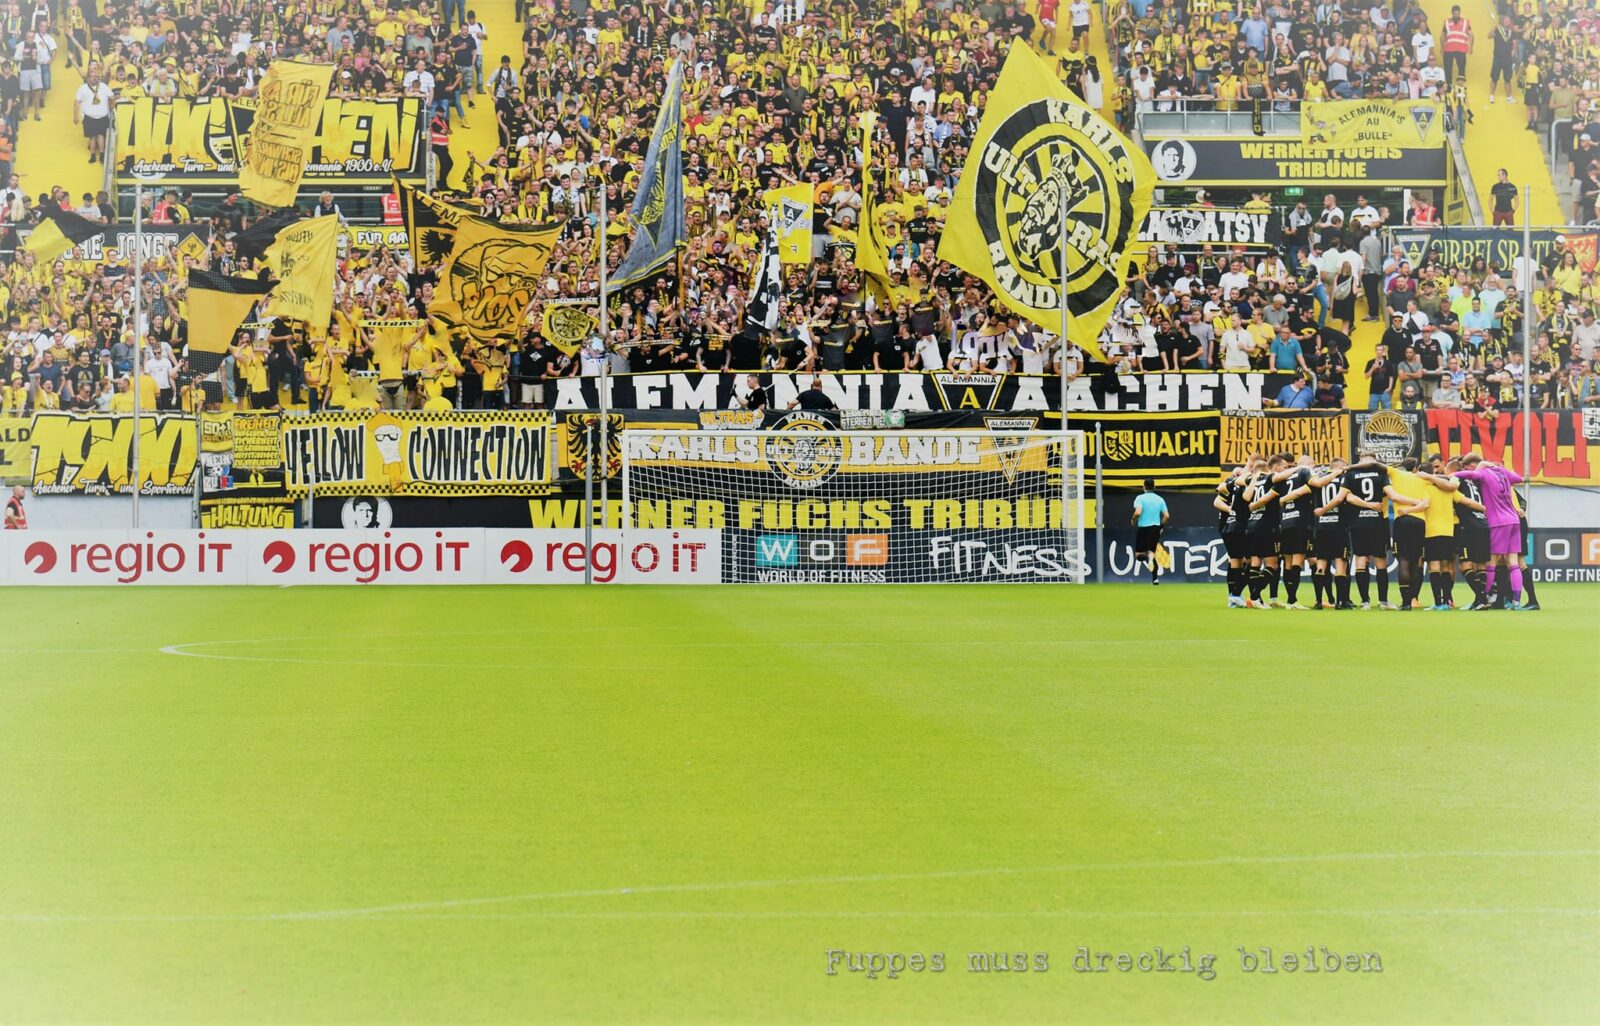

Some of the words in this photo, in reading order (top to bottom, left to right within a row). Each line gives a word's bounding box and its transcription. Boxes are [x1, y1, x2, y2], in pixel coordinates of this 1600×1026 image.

[1366, 117, 1380, 127] AU
[1047, 97, 1135, 184] KARLS
[1239, 143, 1328, 159] WERNER
[344, 159, 373, 173] 1900
[1276, 159, 1367, 178] TRIBÜNE
[1201, 211, 1268, 243] ATSV
[988, 240, 1062, 309] BAND
[940, 375, 997, 384] ALEMANNIA
[960, 386, 981, 409] A
[1227, 416, 1343, 441] FREUNDSCHAFT
[284, 424, 366, 486] YELLOW
[408, 425, 547, 482] CONNECTION
[848, 436, 982, 466] BANDE
[1134, 429, 1218, 457] WACHT
[1426, 409, 1591, 478] TIVOLI
[1361, 477, 1374, 501] 9
[210, 504, 286, 528] HALTUNG
[529, 499, 725, 529] WERNER
[738, 499, 891, 529] FUCHS
[70, 531, 187, 584] regio
[308, 531, 424, 583] regio
[546, 535, 661, 583] rego
[929, 536, 1092, 577] FITNESS
[757, 569, 805, 583] WORLD
[809, 569, 827, 583] OF
[830, 569, 887, 583] FITNESS
[1545, 569, 1563, 582] OF
[1566, 569, 1600, 582] FITNE
